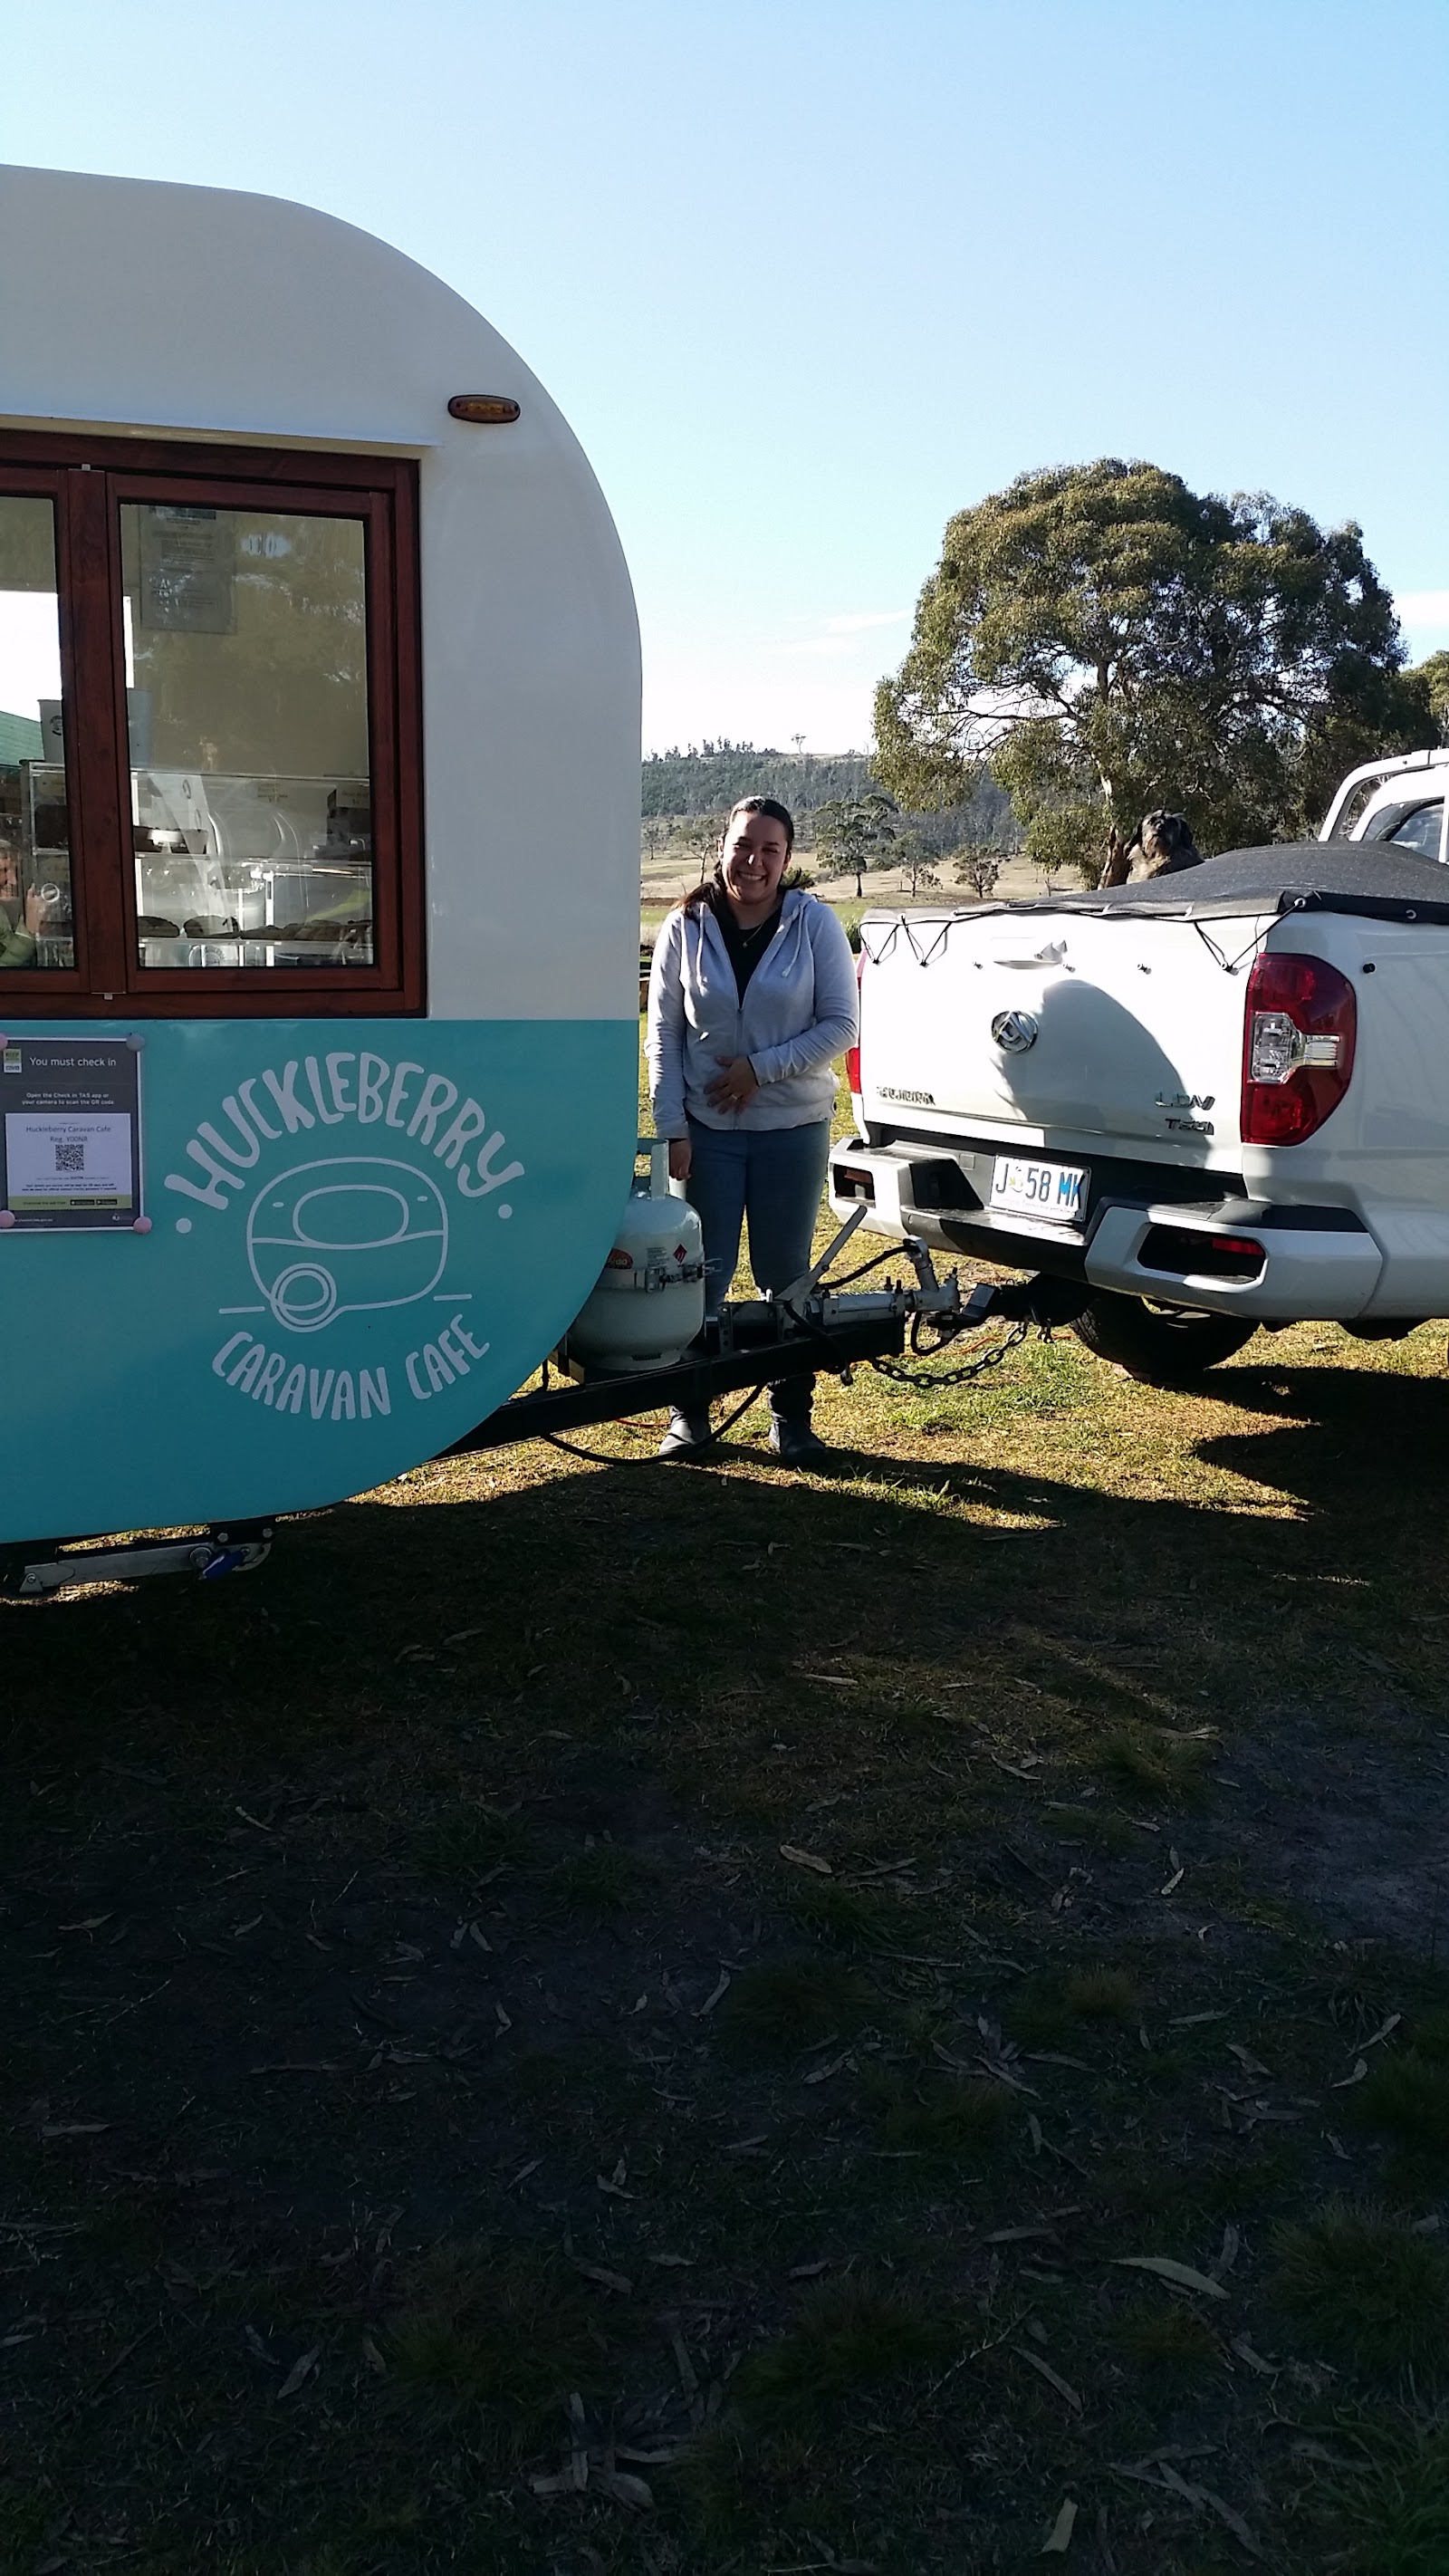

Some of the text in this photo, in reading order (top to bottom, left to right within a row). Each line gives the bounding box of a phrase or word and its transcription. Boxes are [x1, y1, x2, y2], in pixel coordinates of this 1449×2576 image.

[30, 1057, 117, 1066] You must check in
[164, 1052, 525, 1209] HUCKLEBERRY
[1025, 1167, 1051, 1202] 58
[212, 1314, 490, 1420] CARAVAN CAFE
